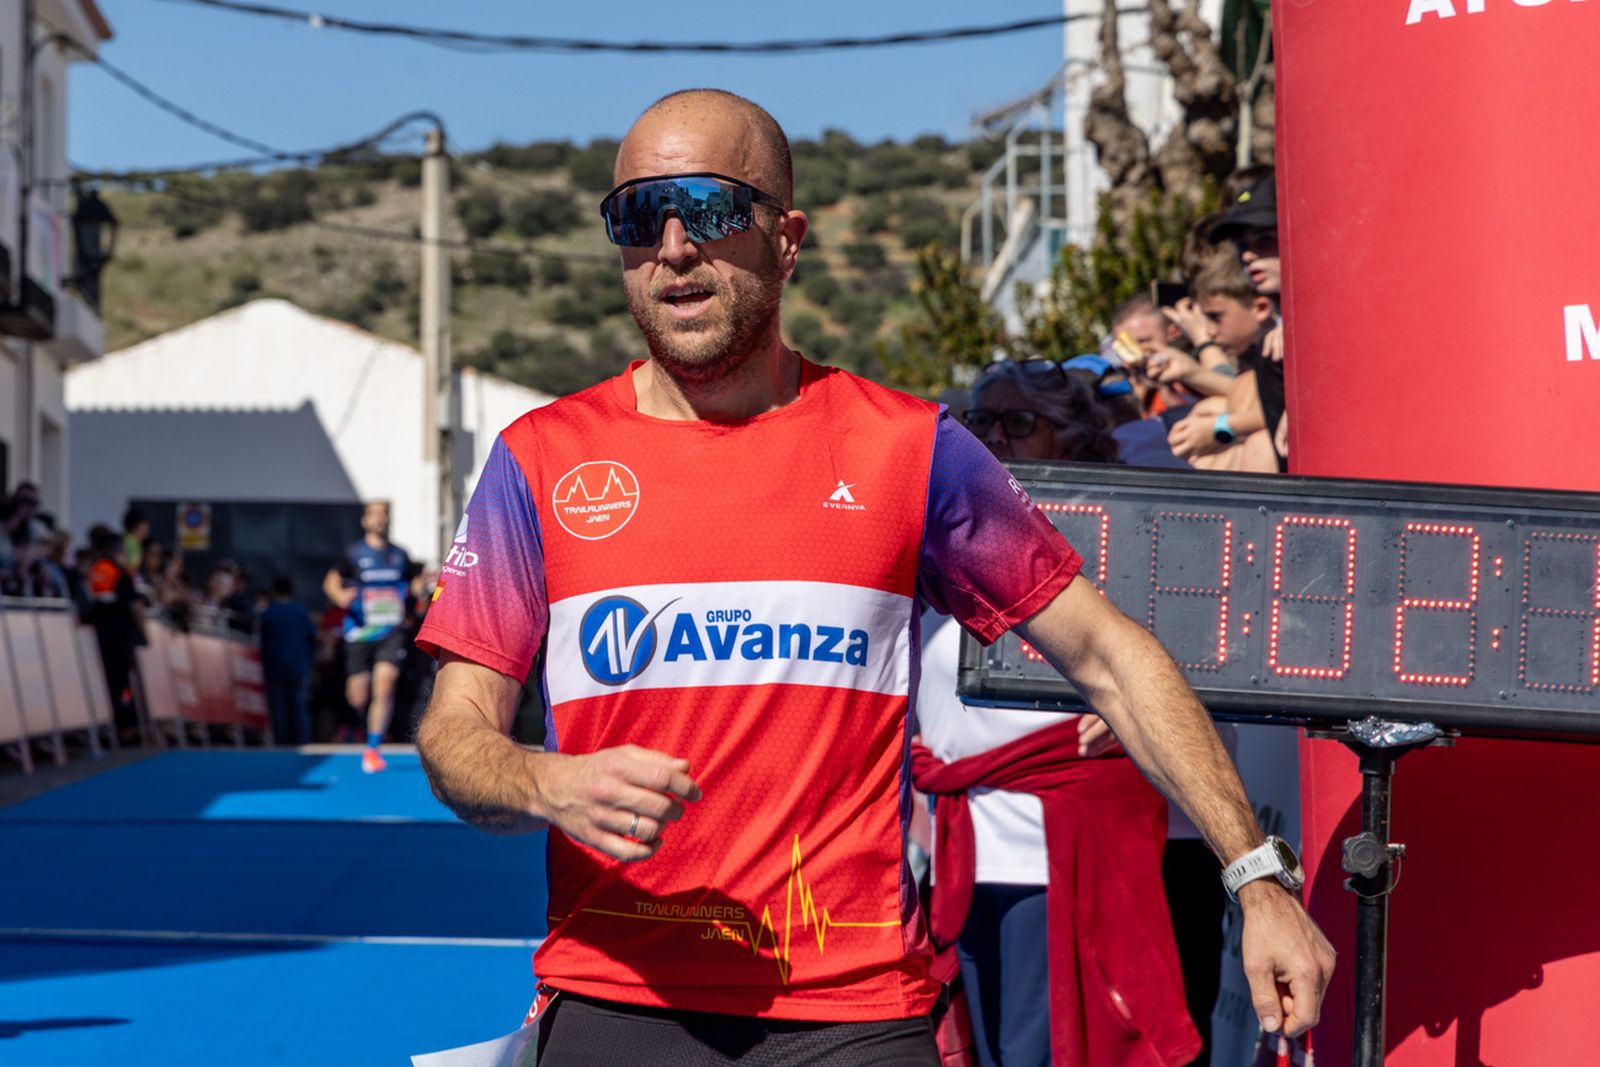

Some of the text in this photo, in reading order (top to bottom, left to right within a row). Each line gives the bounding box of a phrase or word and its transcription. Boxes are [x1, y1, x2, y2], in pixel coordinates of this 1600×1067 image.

[564, 500, 632, 514] TRAILRUNNERS
[822, 501, 866, 511] EVERNYA
[586, 514, 610, 524] JAEN
[706, 609, 752, 623] GRUPO
[664, 612, 869, 667] Avanza
[635, 901, 745, 919] TRAILRUNNERS
[701, 927, 744, 940] JAEN
